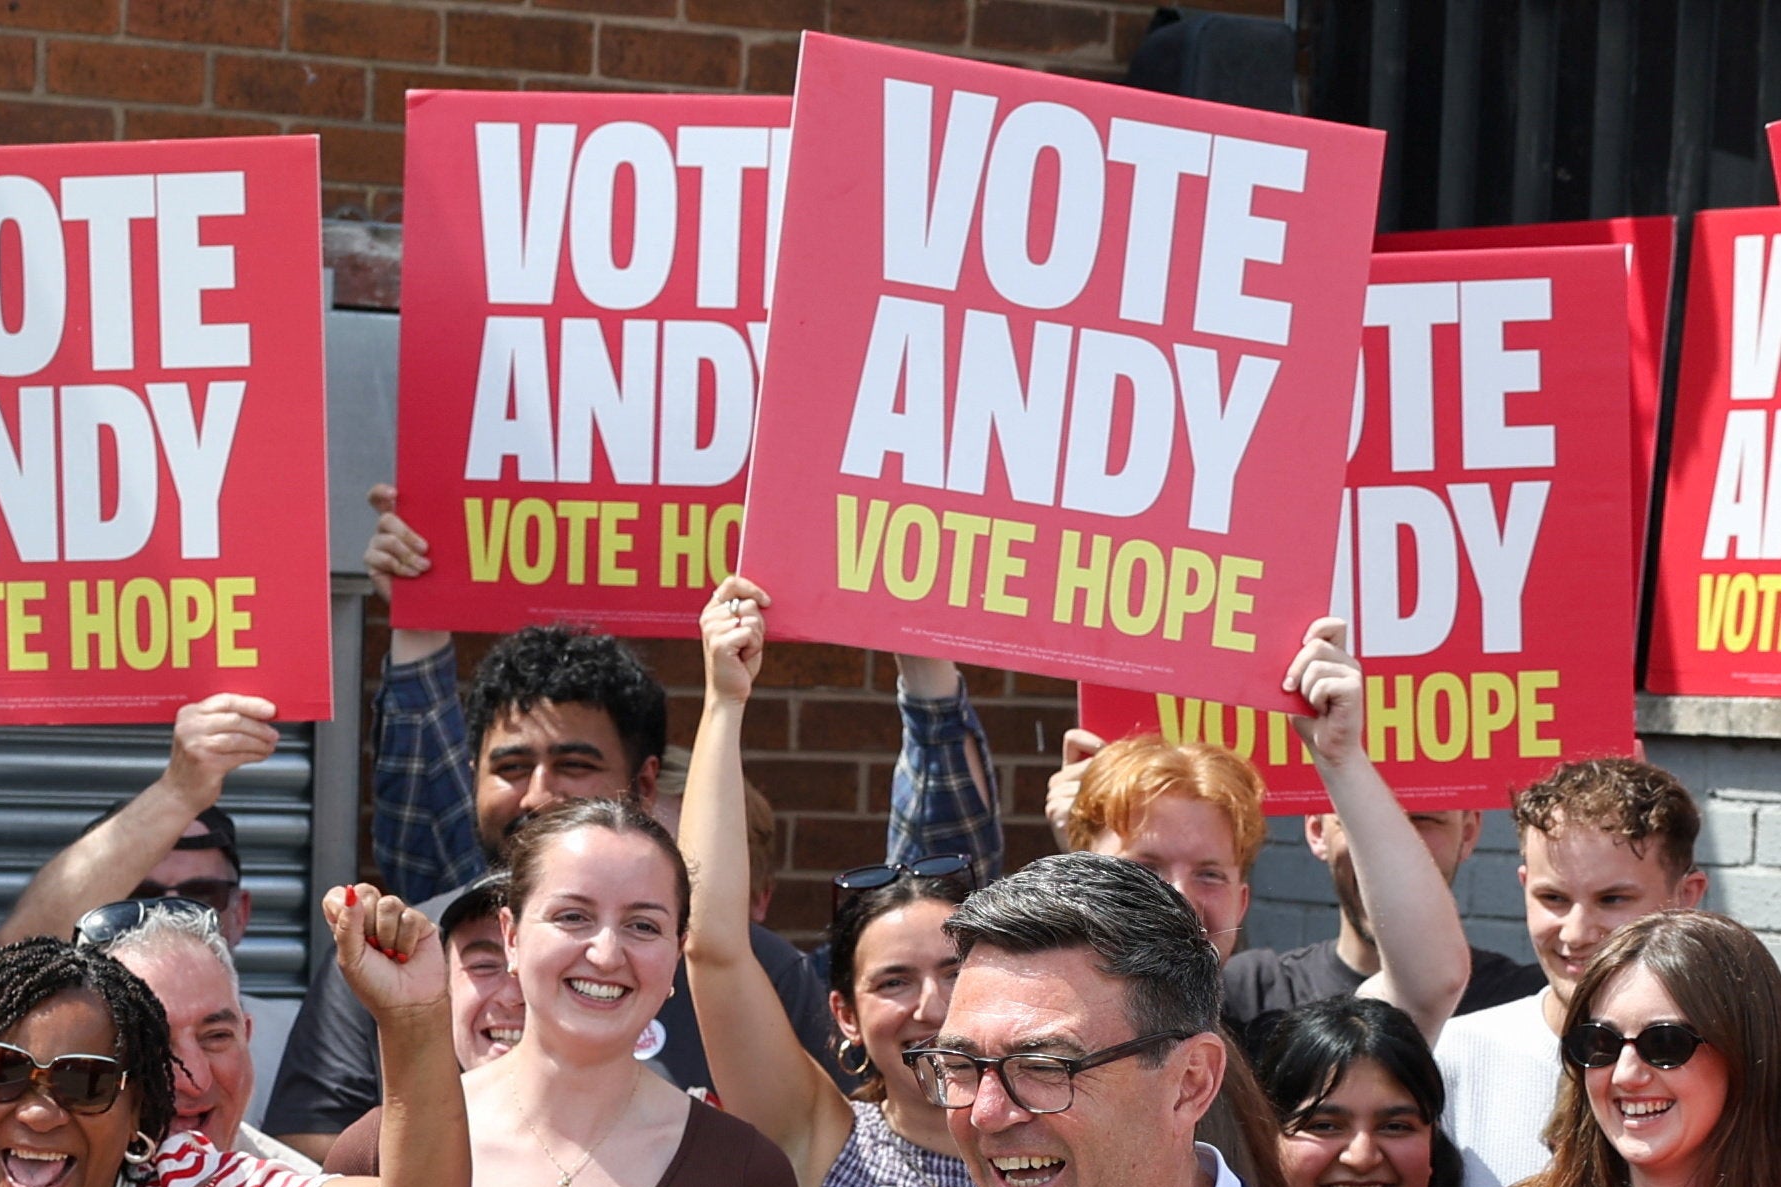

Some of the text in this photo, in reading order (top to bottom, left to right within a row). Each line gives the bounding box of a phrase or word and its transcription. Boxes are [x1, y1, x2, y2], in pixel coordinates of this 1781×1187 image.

[475, 121, 792, 310] VOT
[882, 78, 1308, 346] VOTE
[464, 316, 768, 487] AND
[839, 295, 1281, 534] ANDY
[1347, 278, 1556, 472] TE
[69, 577, 259, 671] HOPE
[464, 498, 745, 589] VOTE HO
[837, 493, 1264, 654] VOTE HOPE
[1328, 480, 1552, 657] DY
[1698, 572, 1781, 653] VOT
[1366, 670, 1561, 763] HOPE
